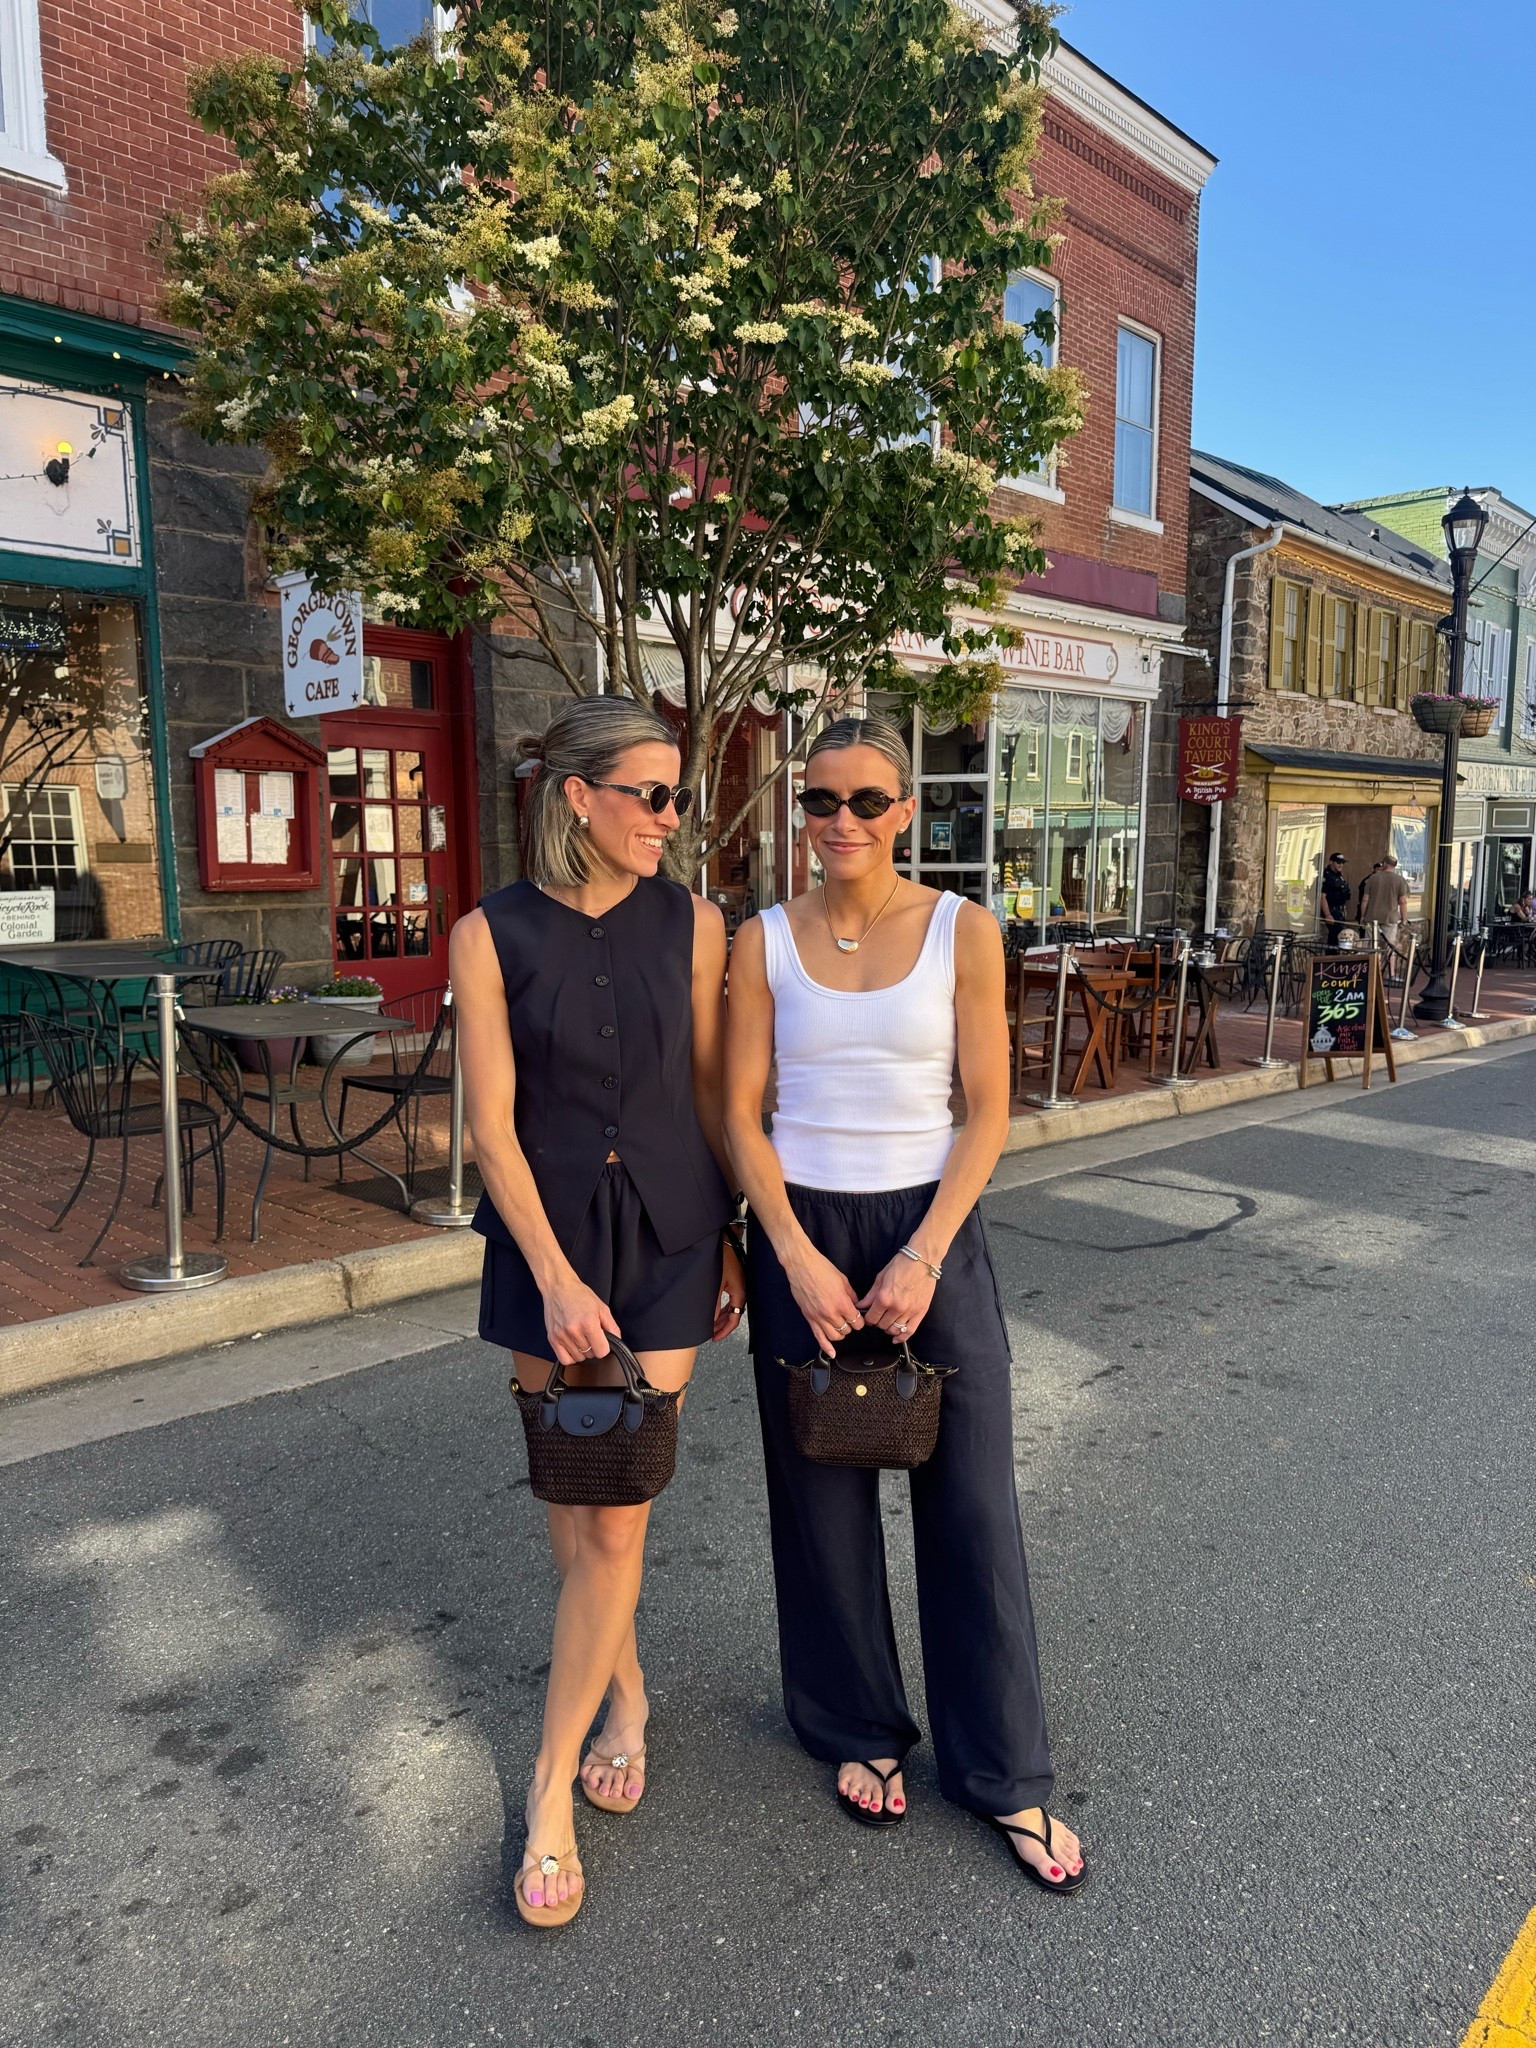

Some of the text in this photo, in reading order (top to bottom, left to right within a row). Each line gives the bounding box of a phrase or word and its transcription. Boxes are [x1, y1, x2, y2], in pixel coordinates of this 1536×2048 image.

[287, 590, 357, 668] GEORGETOWN
[1001, 636, 1049, 668] WINE
[1053, 641, 1086, 675] BAR
[306, 678, 339, 702] CAFE
[1189, 722, 1231, 736] KING'S
[1187, 736, 1231, 749] COURT
[1184, 749, 1232, 763] TAVERN
[1467, 766, 1500, 791] GREEN
[1502, 768, 1527, 792] TREE
[0, 920, 37, 931] Colonial
[8, 930, 43, 939] Garden
[1315, 962, 1368, 980] Kings
[1321, 975, 1362, 988] court
[1317, 1002, 1365, 1025] 365
